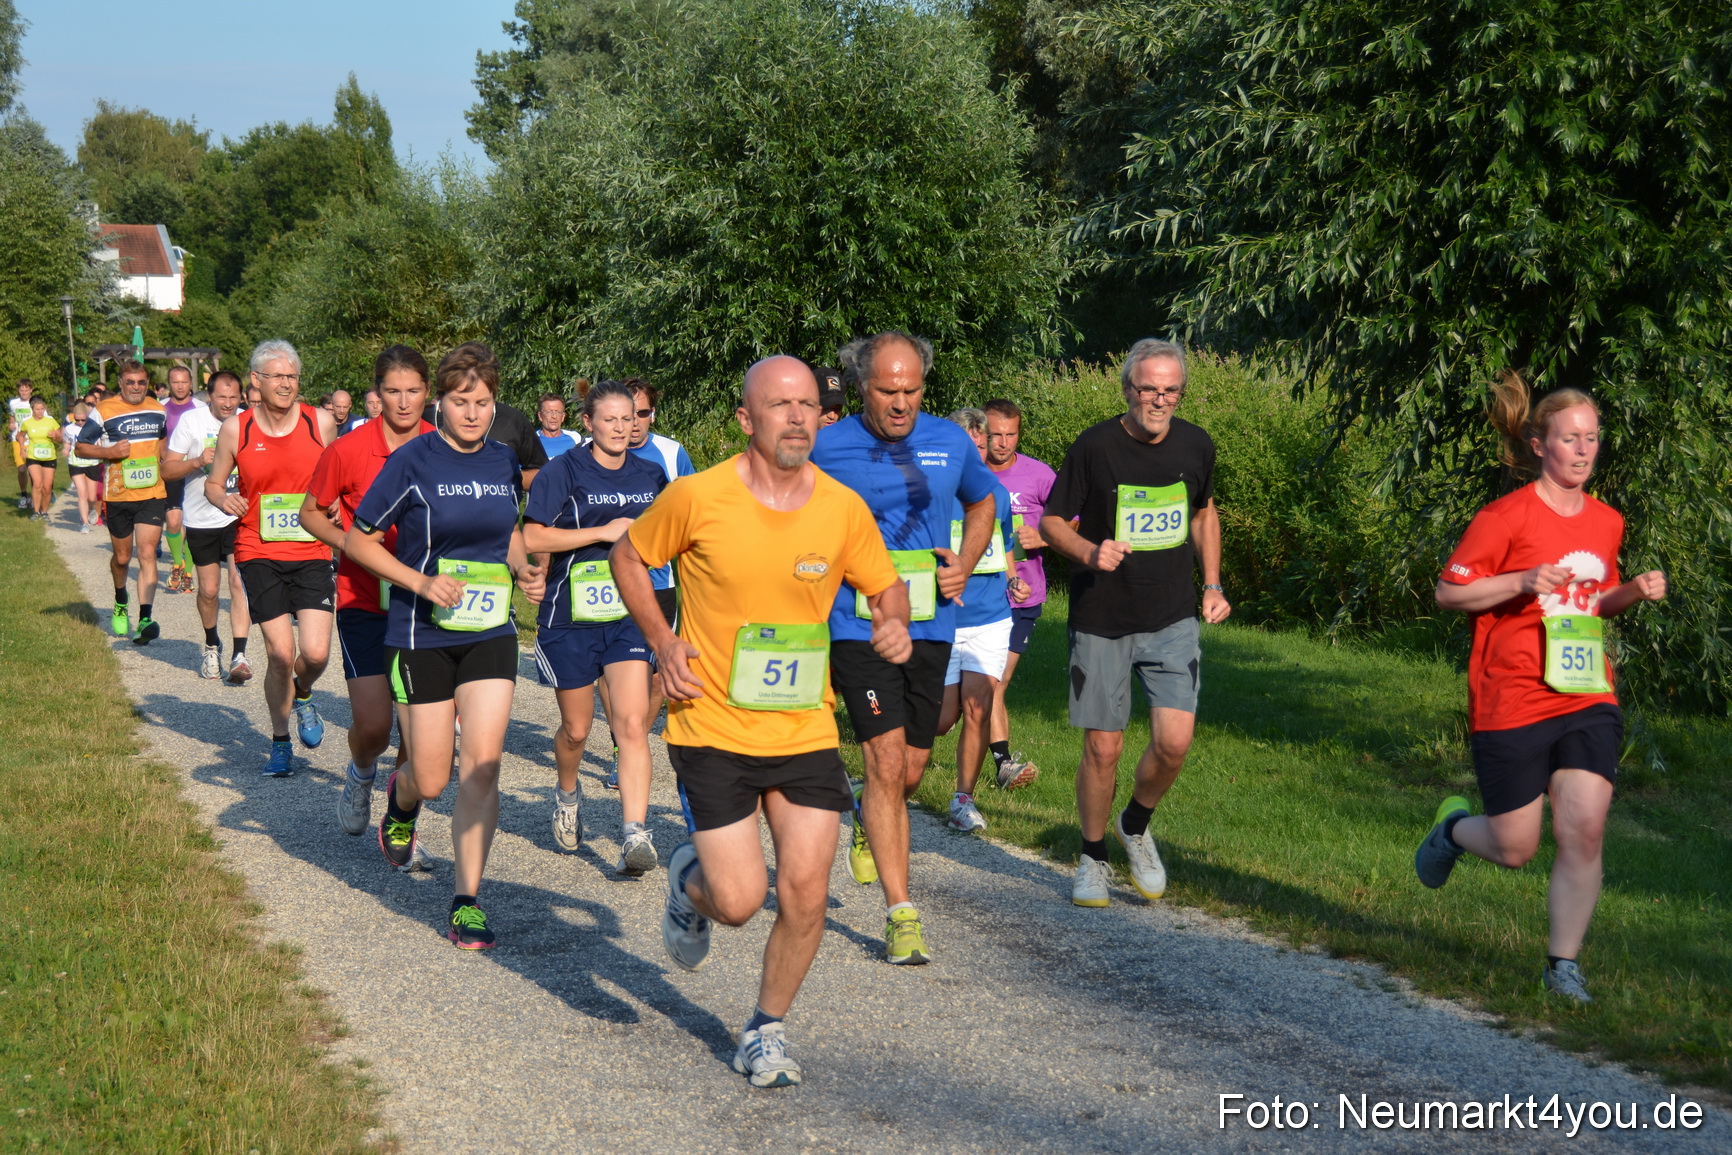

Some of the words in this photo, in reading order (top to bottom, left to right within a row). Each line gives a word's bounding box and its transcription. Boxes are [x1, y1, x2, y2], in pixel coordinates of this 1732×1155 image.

[126, 421, 159, 432] Fischer
[130, 469, 152, 480] 406
[438, 484, 473, 497] EURO
[482, 484, 509, 497] POLES
[587, 494, 618, 505] EURO
[625, 491, 655, 504] POLES
[1125, 509, 1182, 533] 1239
[1450, 563, 1470, 577] SEBI
[1561, 646, 1593, 671] 551
[762, 659, 799, 687] 51
